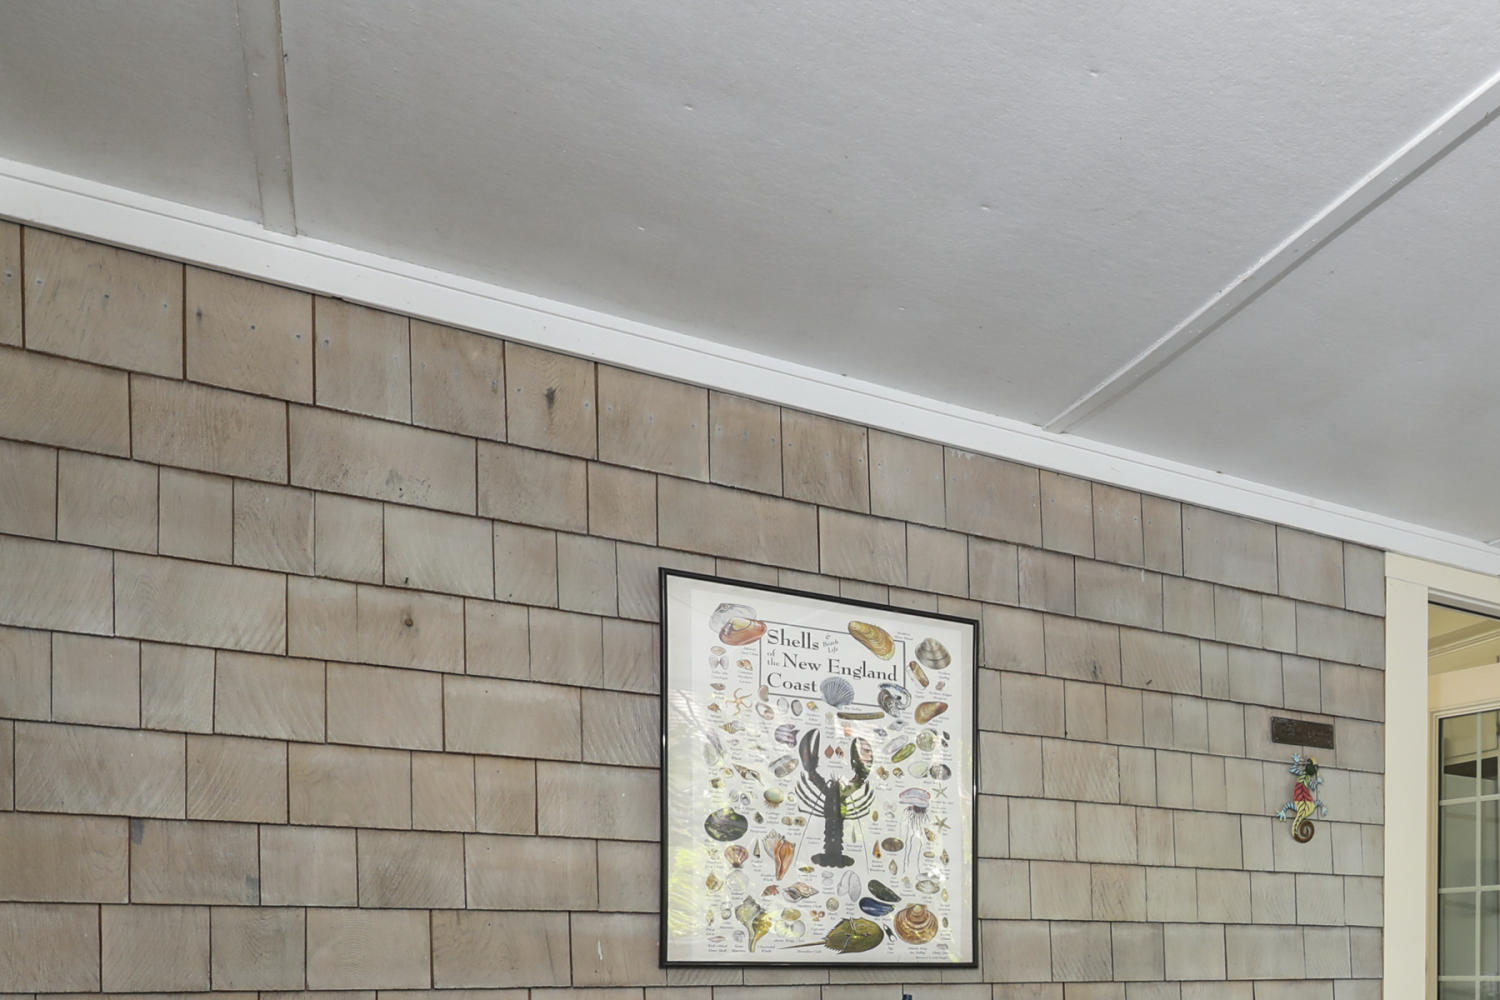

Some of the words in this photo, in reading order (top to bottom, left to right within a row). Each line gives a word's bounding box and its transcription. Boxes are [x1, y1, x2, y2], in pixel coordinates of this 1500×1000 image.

[767, 628, 820, 650] Shells
[767, 648, 776, 657] of
[767, 659, 780, 667] the
[783, 652, 822, 671] New
[828, 658, 898, 682] England
[767, 672, 817, 693] Coast
